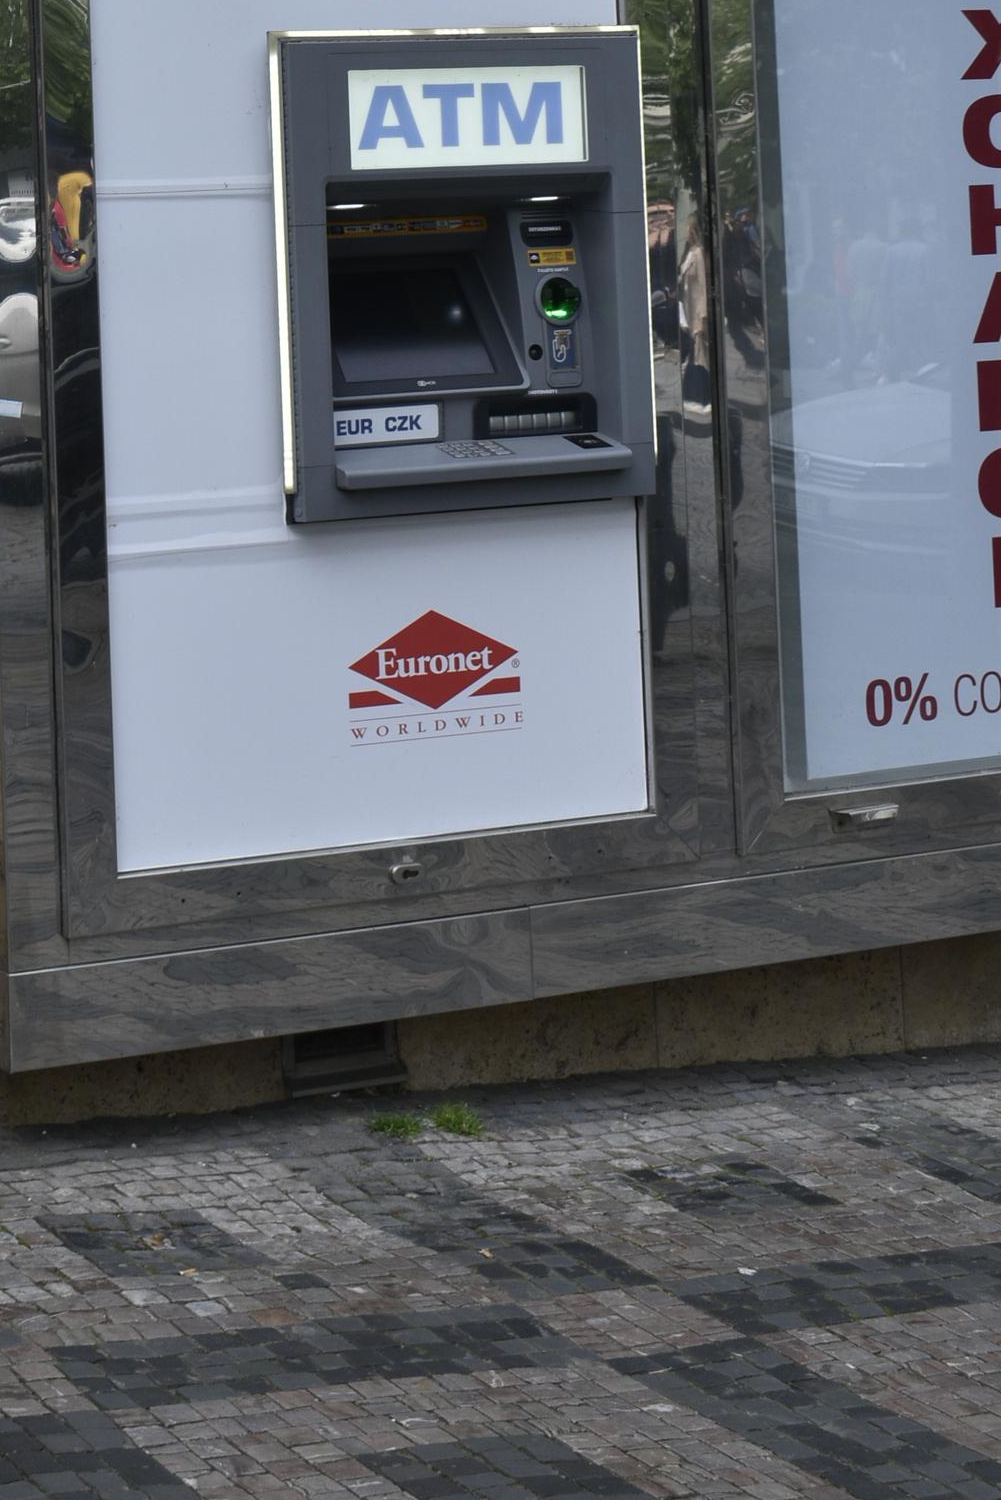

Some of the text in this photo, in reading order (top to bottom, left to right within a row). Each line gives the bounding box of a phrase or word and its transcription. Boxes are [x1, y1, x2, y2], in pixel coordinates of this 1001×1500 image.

[358, 81, 564, 151] ATM
[336, 414, 422, 436] EUR CZK
[375, 646, 493, 680] Euronet
[865, 671, 1001, 727] 0% CO
[351, 711, 524, 740] WORLDWIDE
